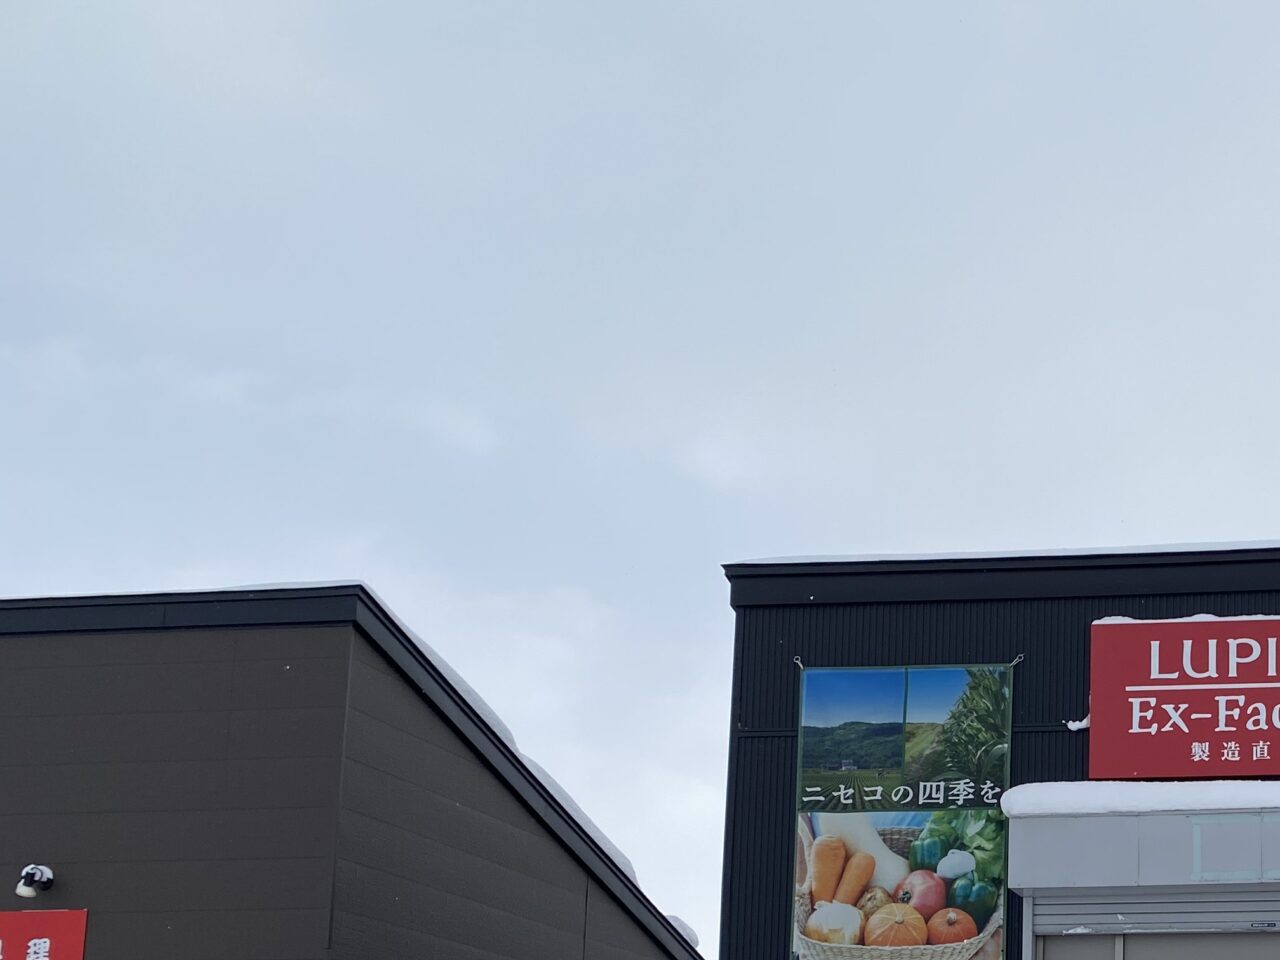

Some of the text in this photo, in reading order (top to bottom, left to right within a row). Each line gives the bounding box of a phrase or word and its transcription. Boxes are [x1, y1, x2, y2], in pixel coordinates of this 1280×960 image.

[802, 779, 1001, 806] ニセコの四季を
